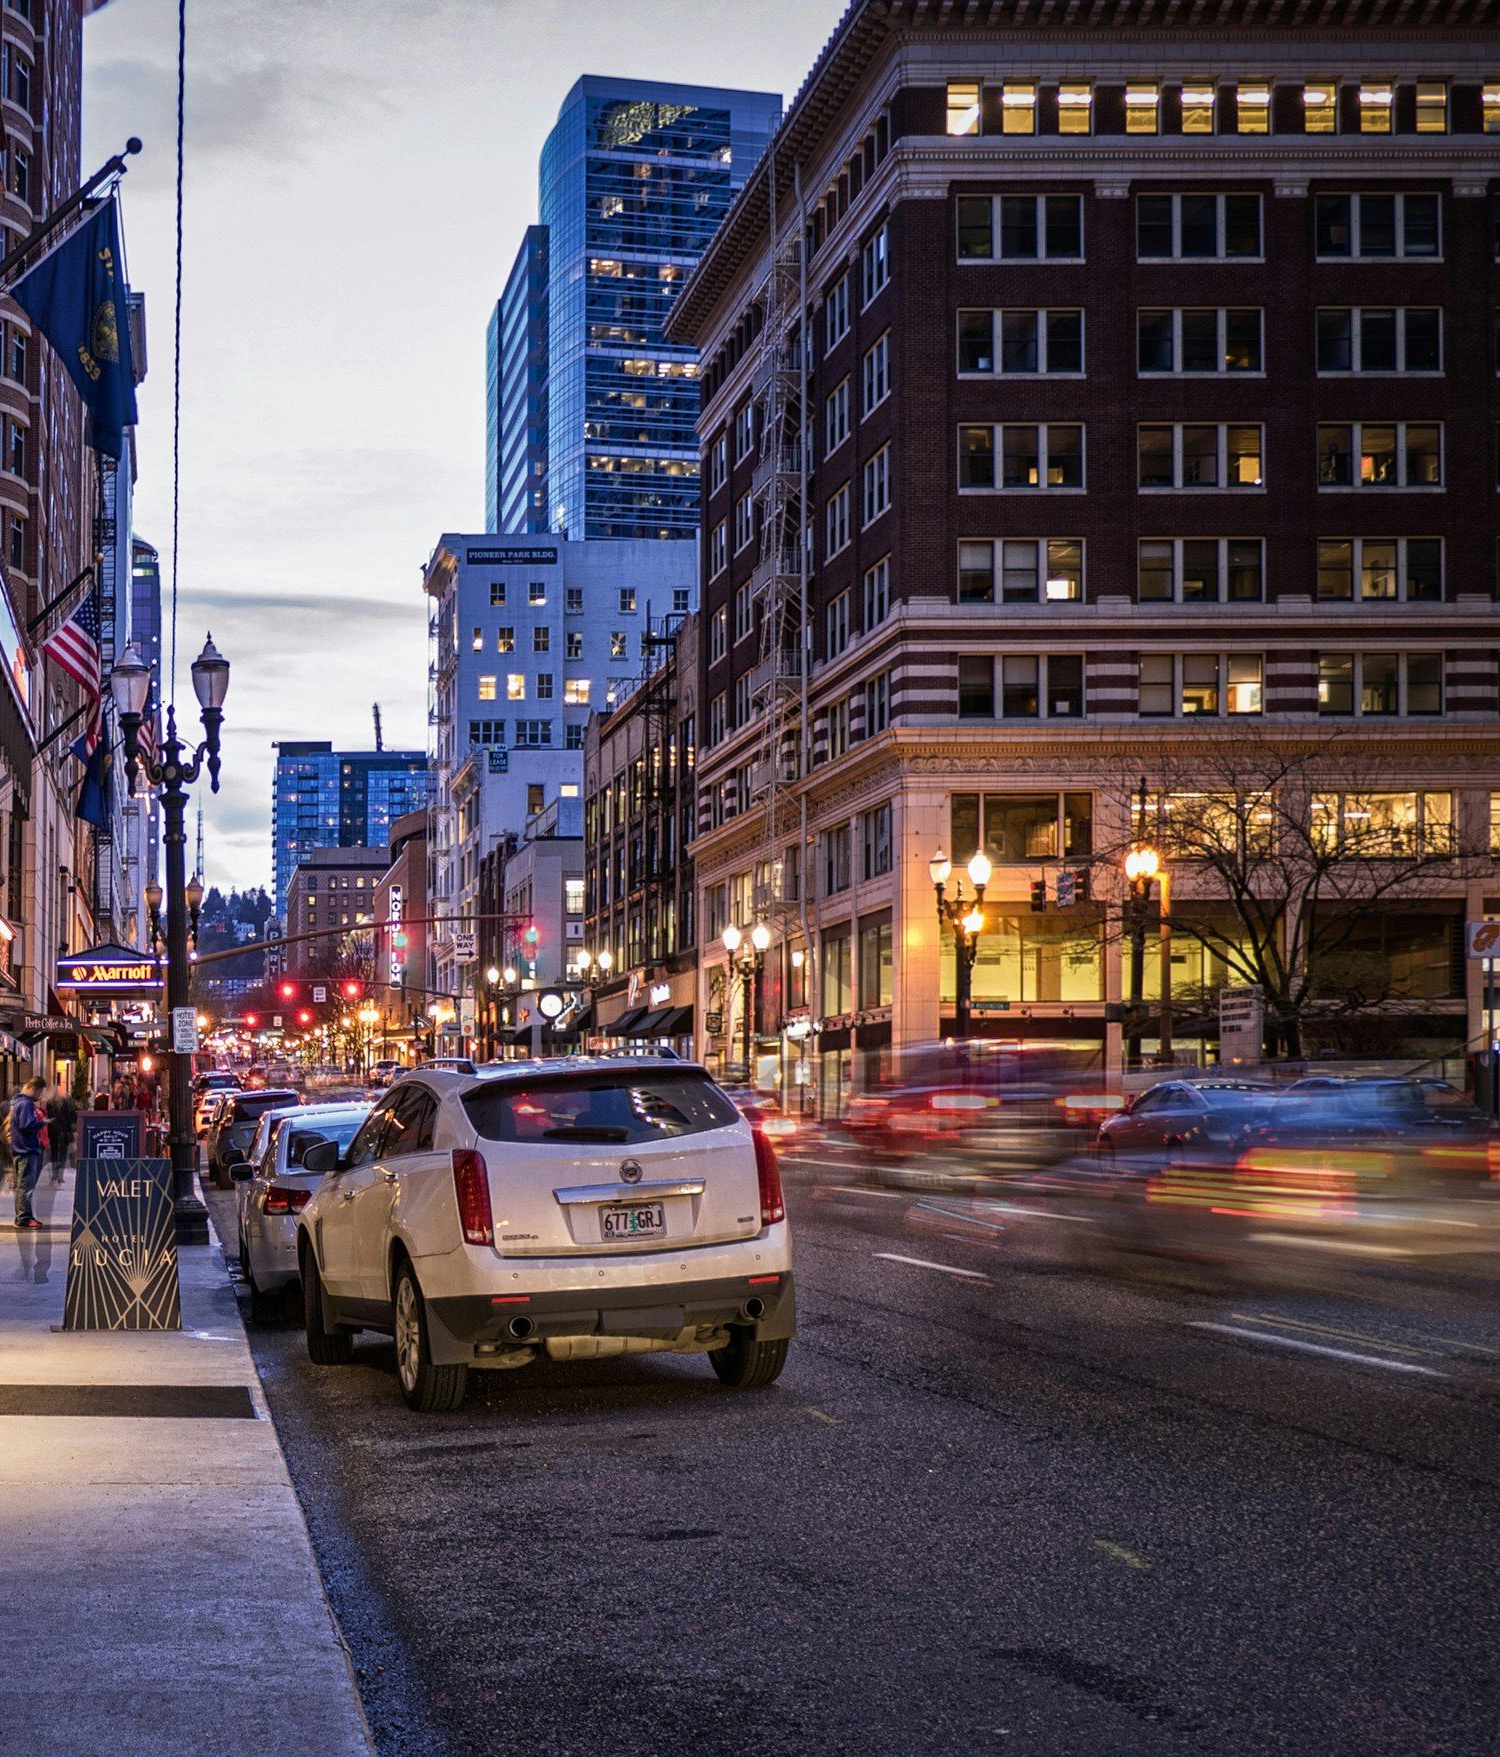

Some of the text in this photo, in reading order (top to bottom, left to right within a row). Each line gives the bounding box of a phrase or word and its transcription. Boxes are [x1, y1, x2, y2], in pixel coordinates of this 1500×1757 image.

[78, 345, 101, 380] 1859
[468, 551, 556, 559] PIONEER PARK BLDG.
[88, 965, 152, 982] Marriott
[41, 1017, 59, 1030] Coffee
[93, 1130, 129, 1139] HAPPY HOUR
[96, 1180, 153, 1198] VALET
[605, 1210, 663, 1231] 677 GRJ
[101, 1234, 146, 1244] HOTEL
[73, 1249, 173, 1267] LUCIA
